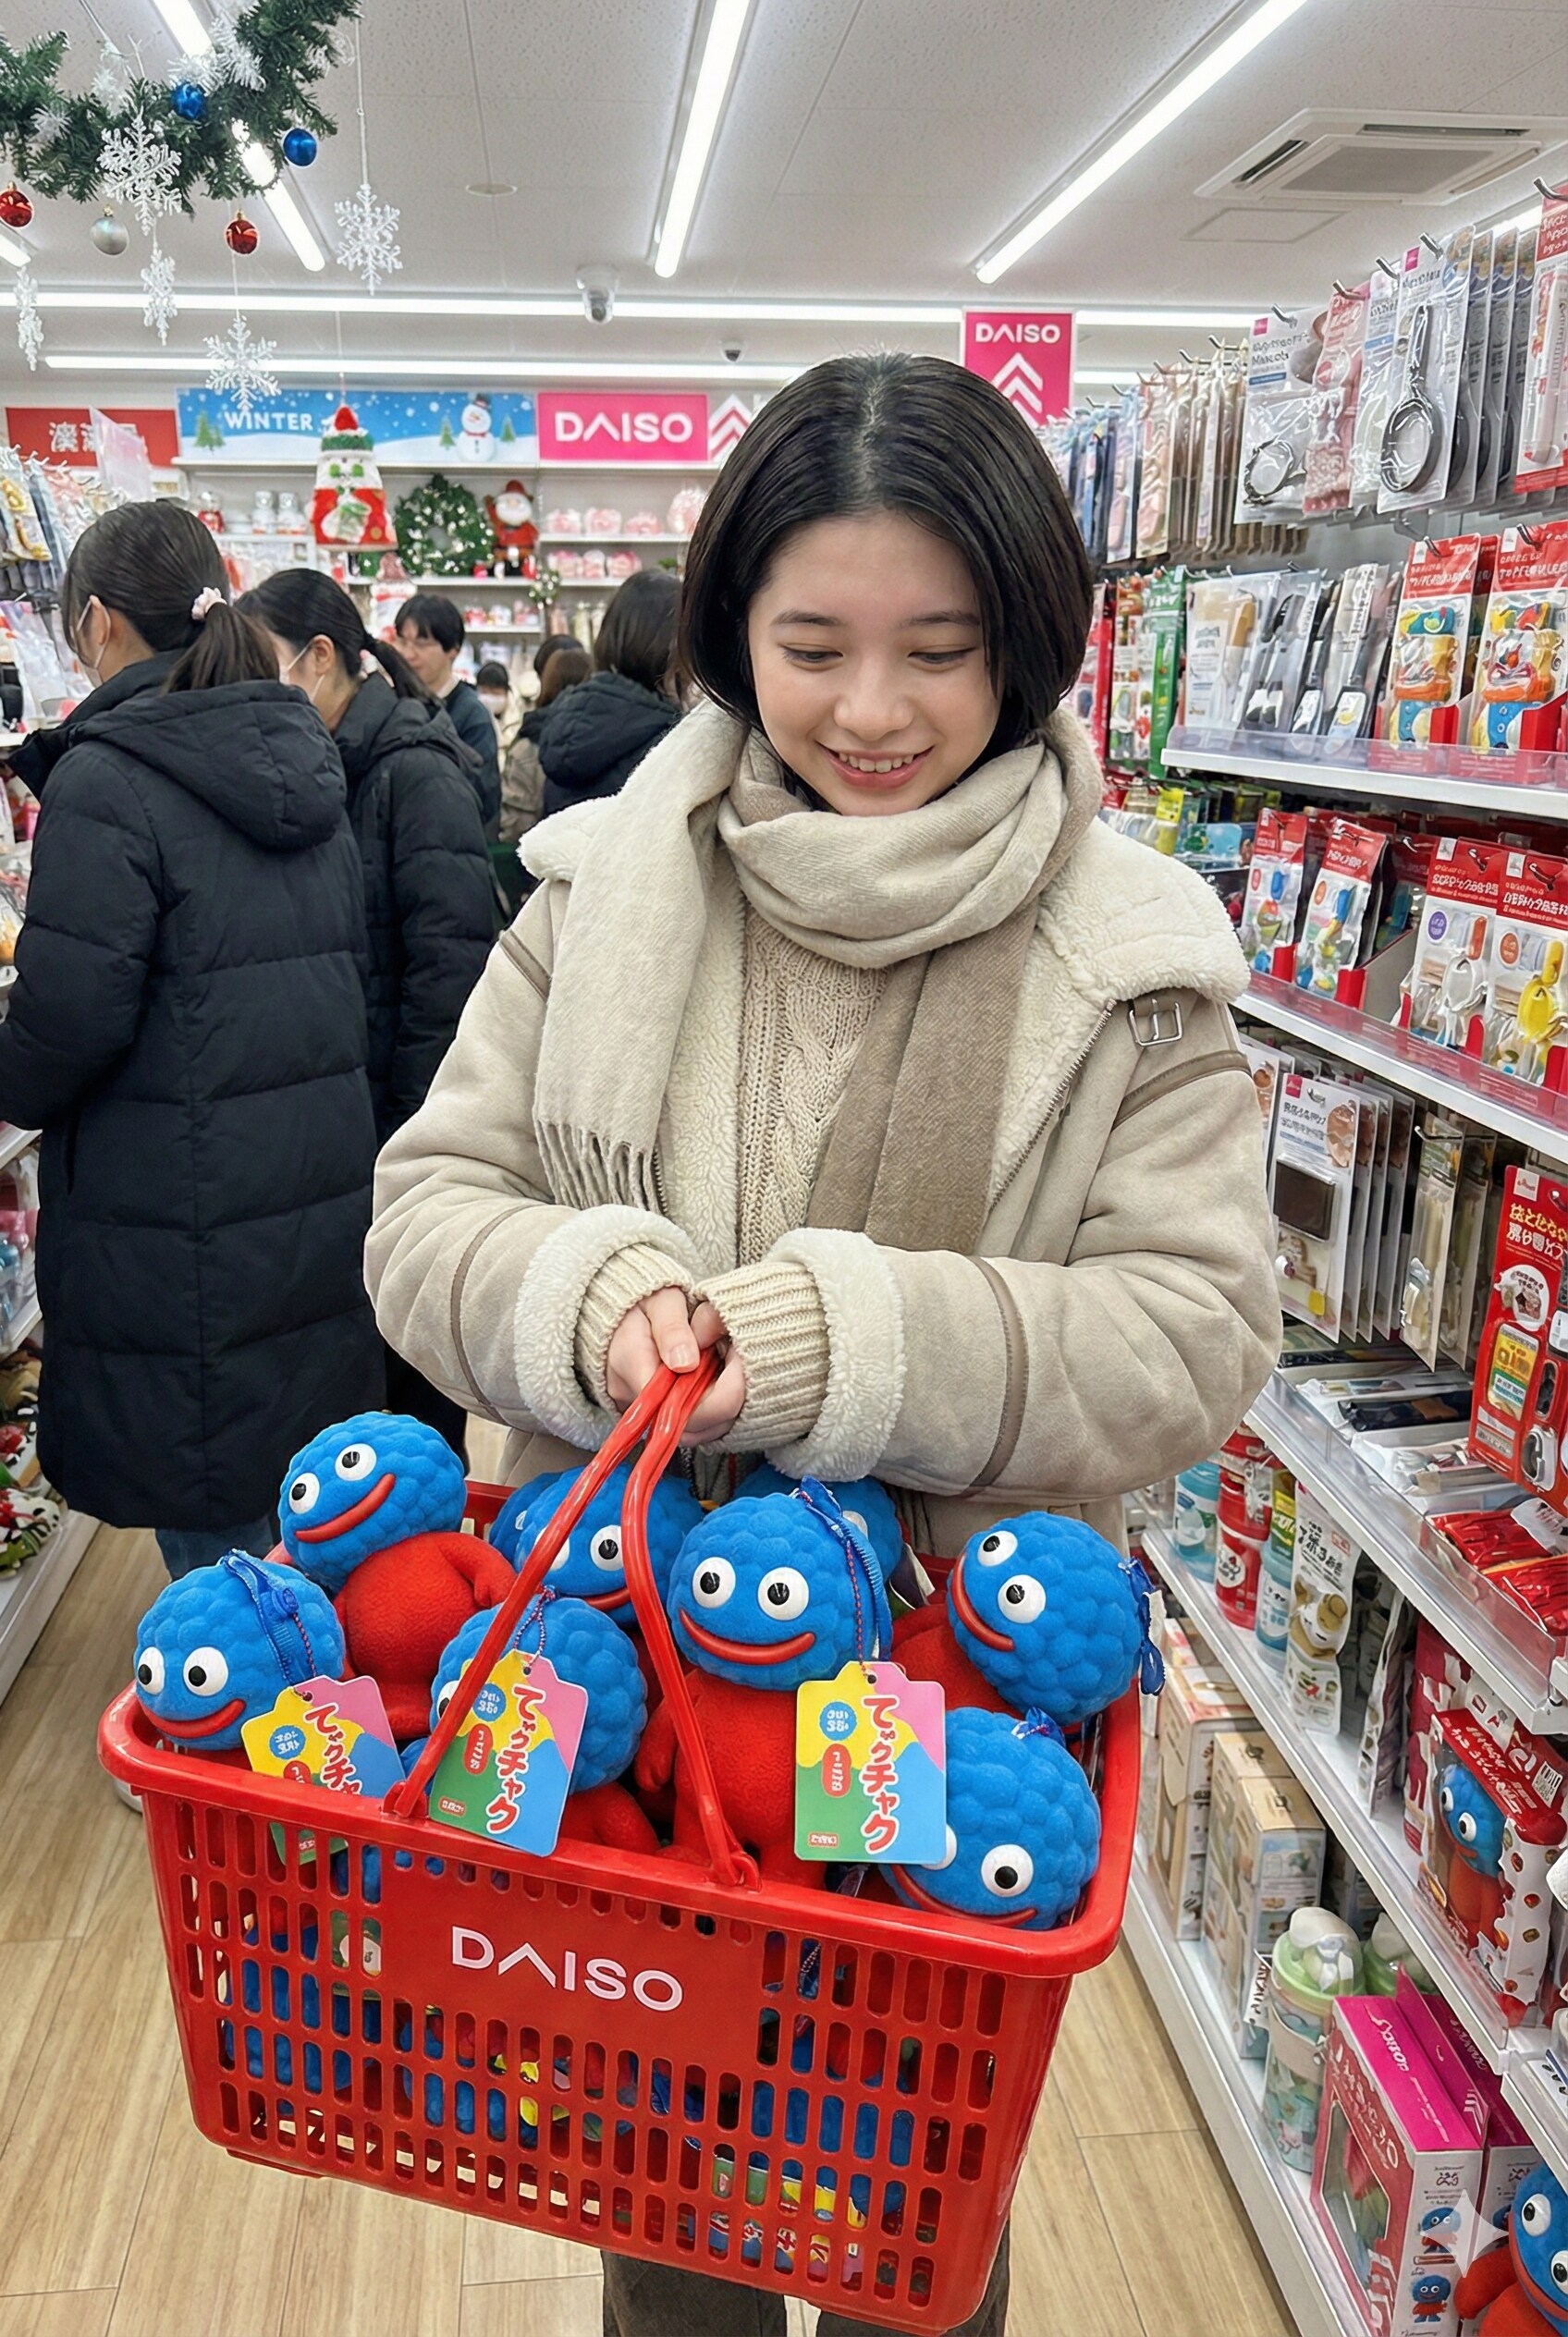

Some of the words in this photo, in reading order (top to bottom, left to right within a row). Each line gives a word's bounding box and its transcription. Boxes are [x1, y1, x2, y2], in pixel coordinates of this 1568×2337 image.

[974, 322, 1061, 344] DAISO
[223, 410, 314, 431] WINTER
[555, 410, 693, 444] DAISO
[451, 1925, 684, 2013] DAISO
